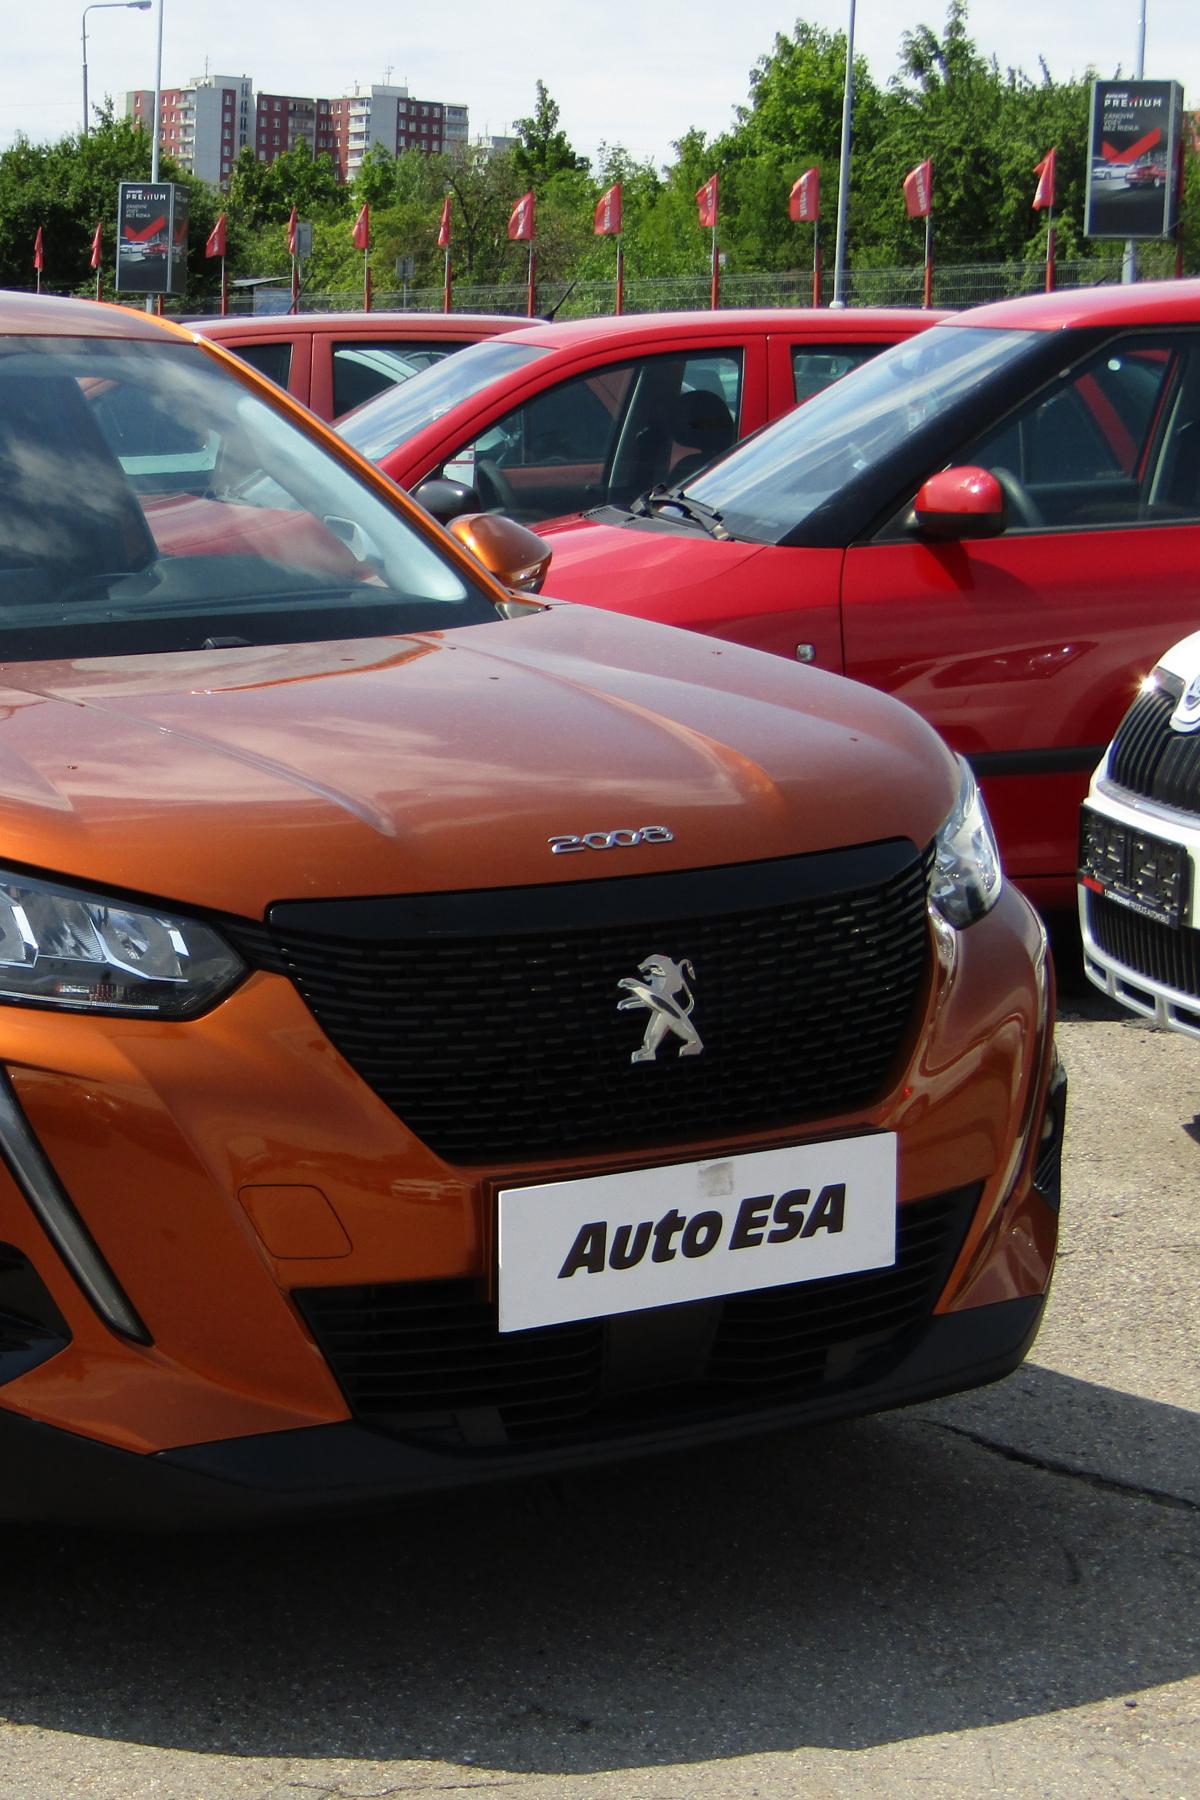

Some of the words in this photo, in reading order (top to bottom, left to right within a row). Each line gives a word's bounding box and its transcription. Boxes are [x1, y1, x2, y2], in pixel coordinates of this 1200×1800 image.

[548, 825, 674, 854] 2008
[557, 1208, 723, 1279] Auto
[728, 1182, 847, 1251] ESA
